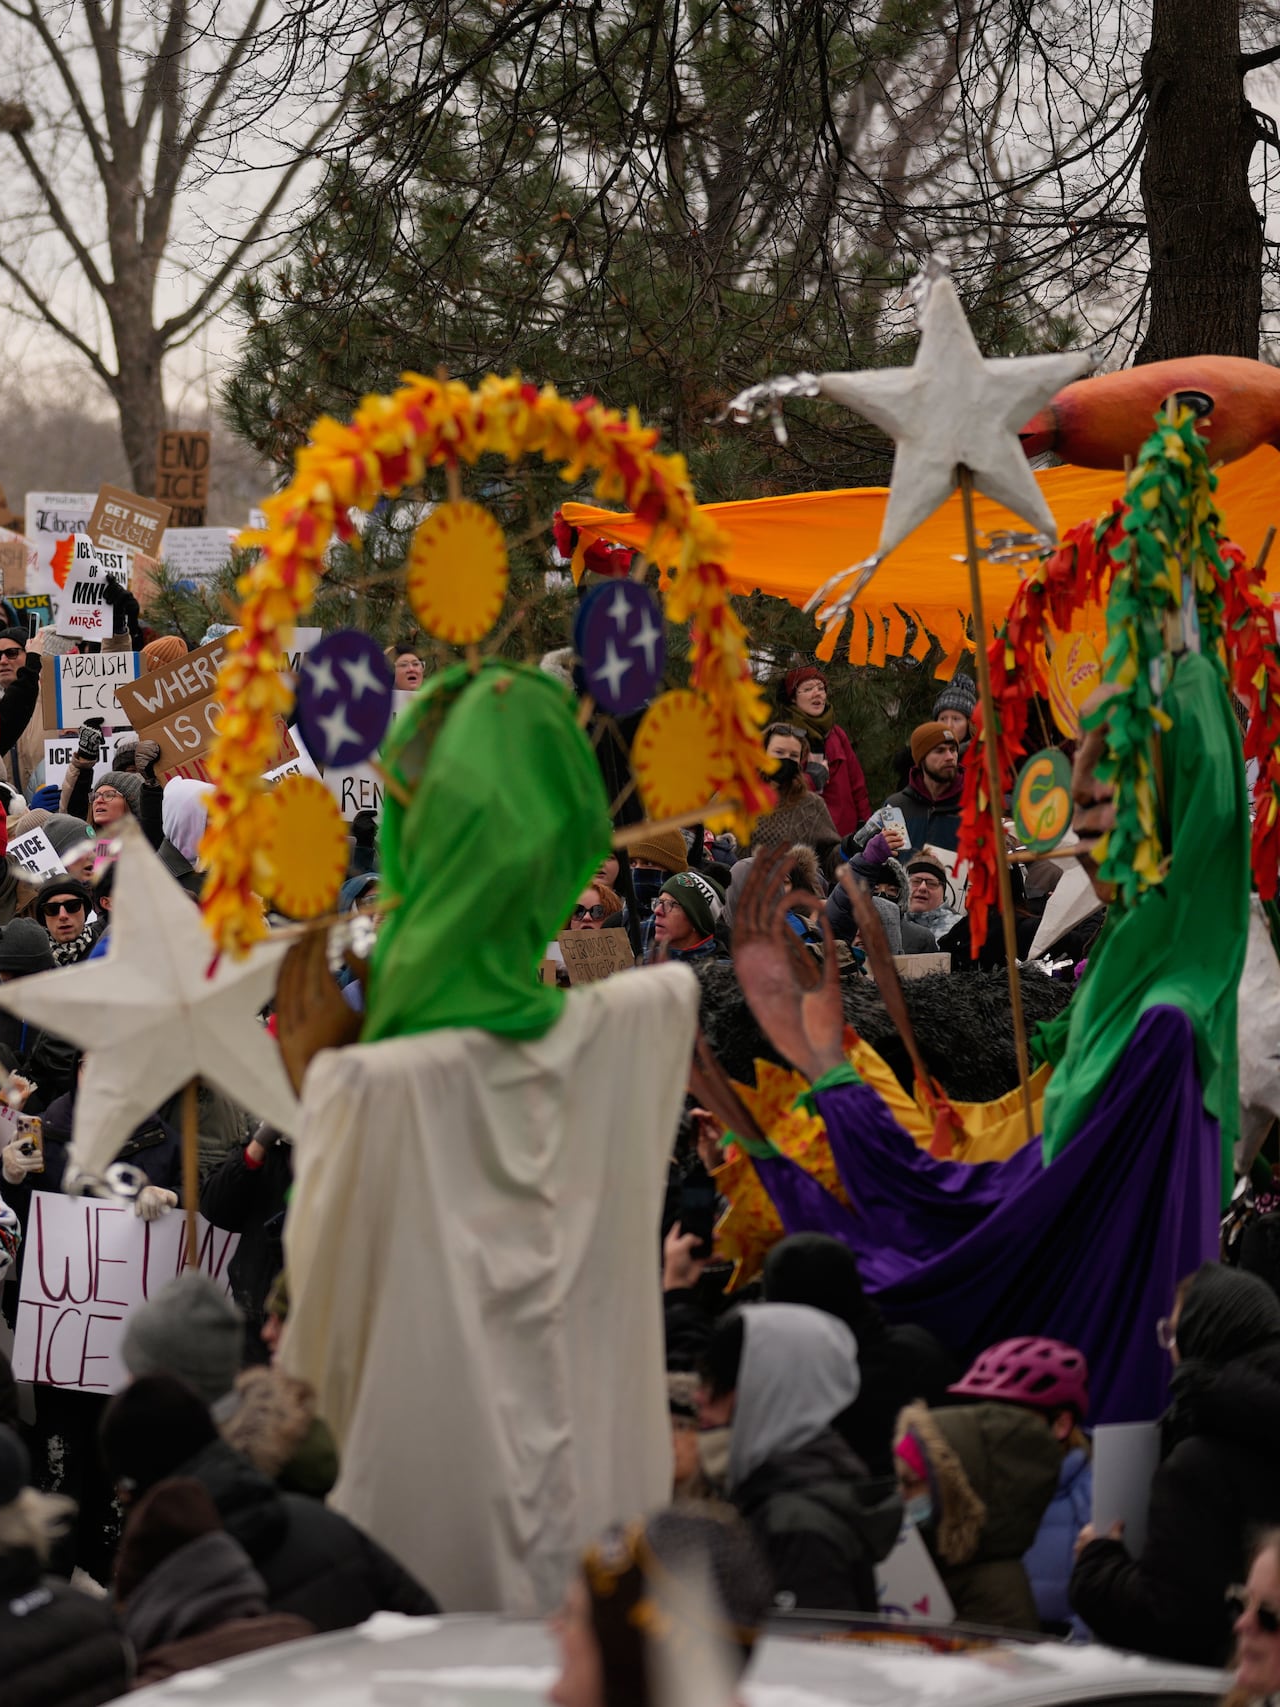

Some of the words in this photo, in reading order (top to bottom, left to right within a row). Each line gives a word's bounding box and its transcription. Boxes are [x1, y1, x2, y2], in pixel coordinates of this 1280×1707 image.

[162, 435, 210, 470] END
[159, 474, 205, 499] ICE
[104, 503, 131, 519] GET
[133, 512, 160, 531] THE
[97, 514, 155, 549] FUCK
[77, 542, 91, 559] ICE
[89, 565, 98, 578] OF
[72, 581, 106, 605] MN!
[69, 616, 102, 628] MIRAC
[62, 655, 128, 679] ABOLISH
[70, 683, 129, 710] ICE
[163, 716, 201, 753] IS
[49, 747, 73, 765] ICE
[563, 935, 618, 960] TRUMP
[37, 1196, 128, 1306] WE
[17, 1300, 123, 1387] ICE
